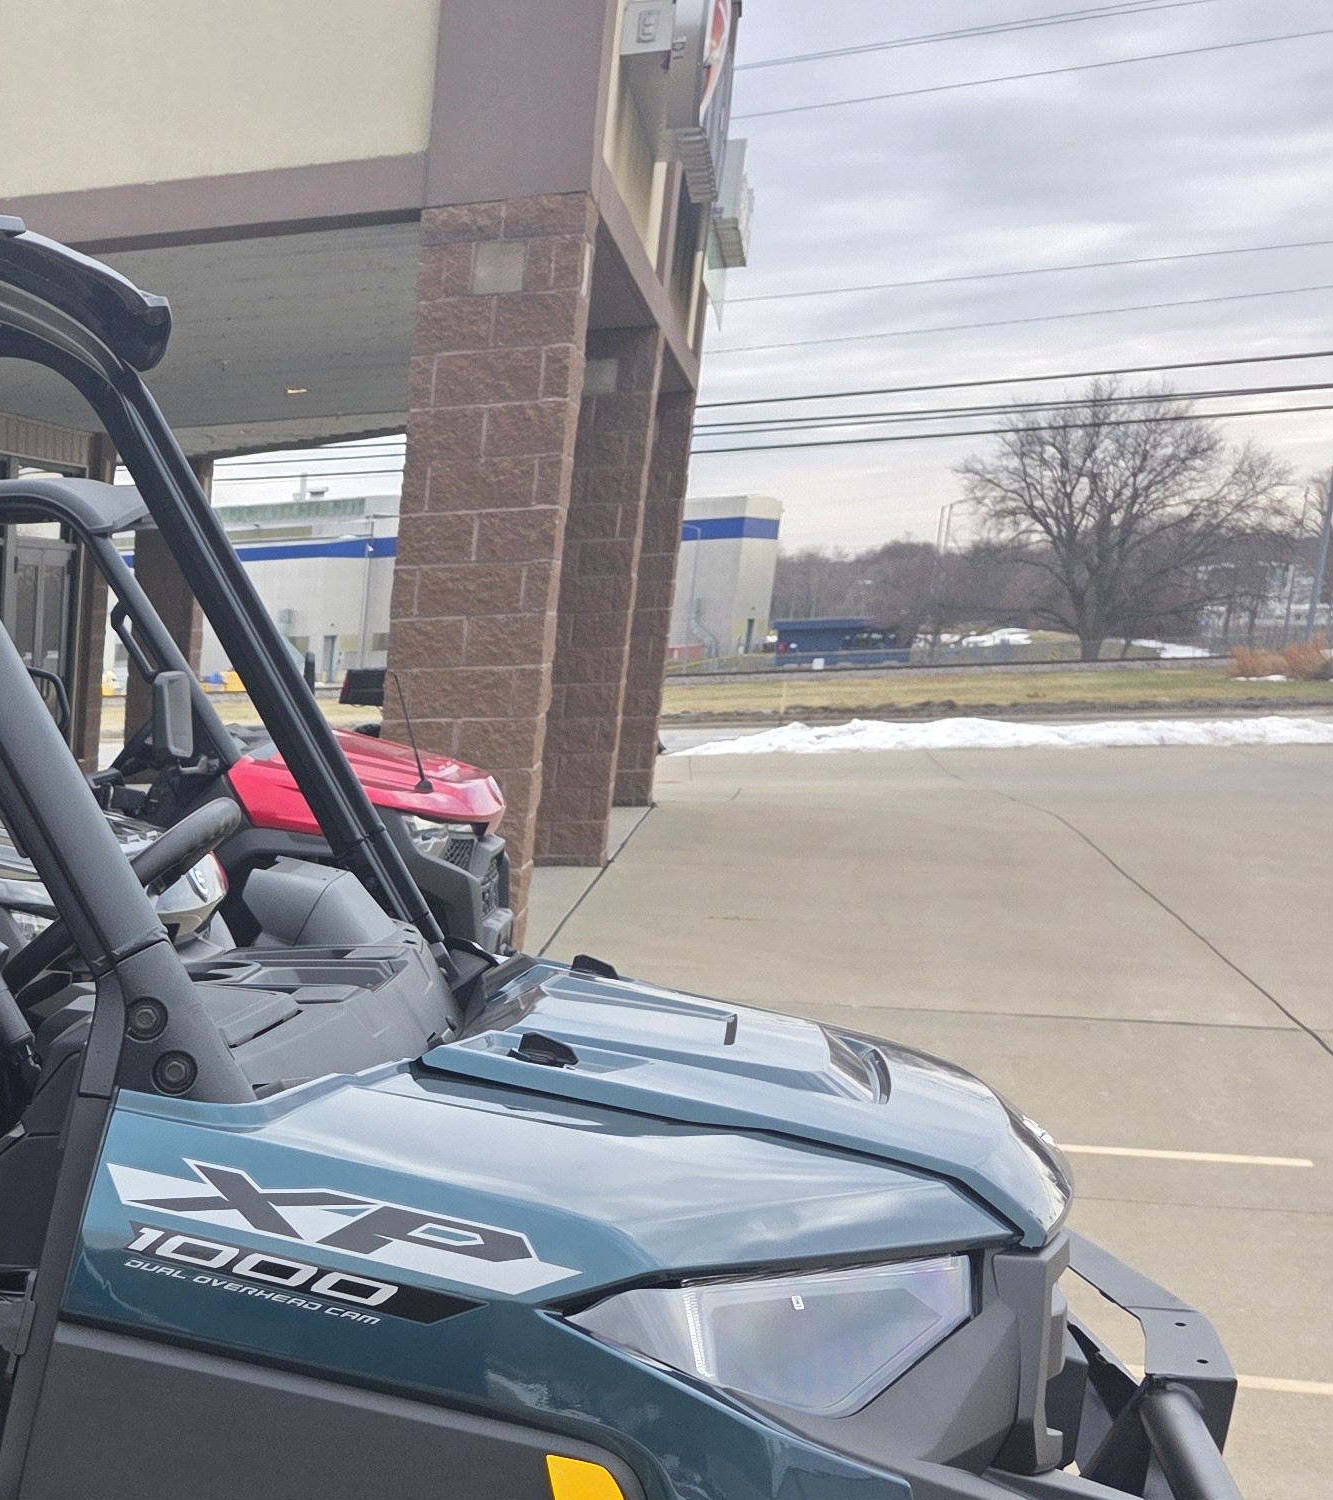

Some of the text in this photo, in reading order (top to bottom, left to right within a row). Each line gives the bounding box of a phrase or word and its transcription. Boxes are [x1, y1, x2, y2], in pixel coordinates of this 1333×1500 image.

[124, 1158, 539, 1263] XP
[124, 1259, 381, 1325] DUAL OVERHEAD CAM
[126, 1226, 399, 1307] 1000
